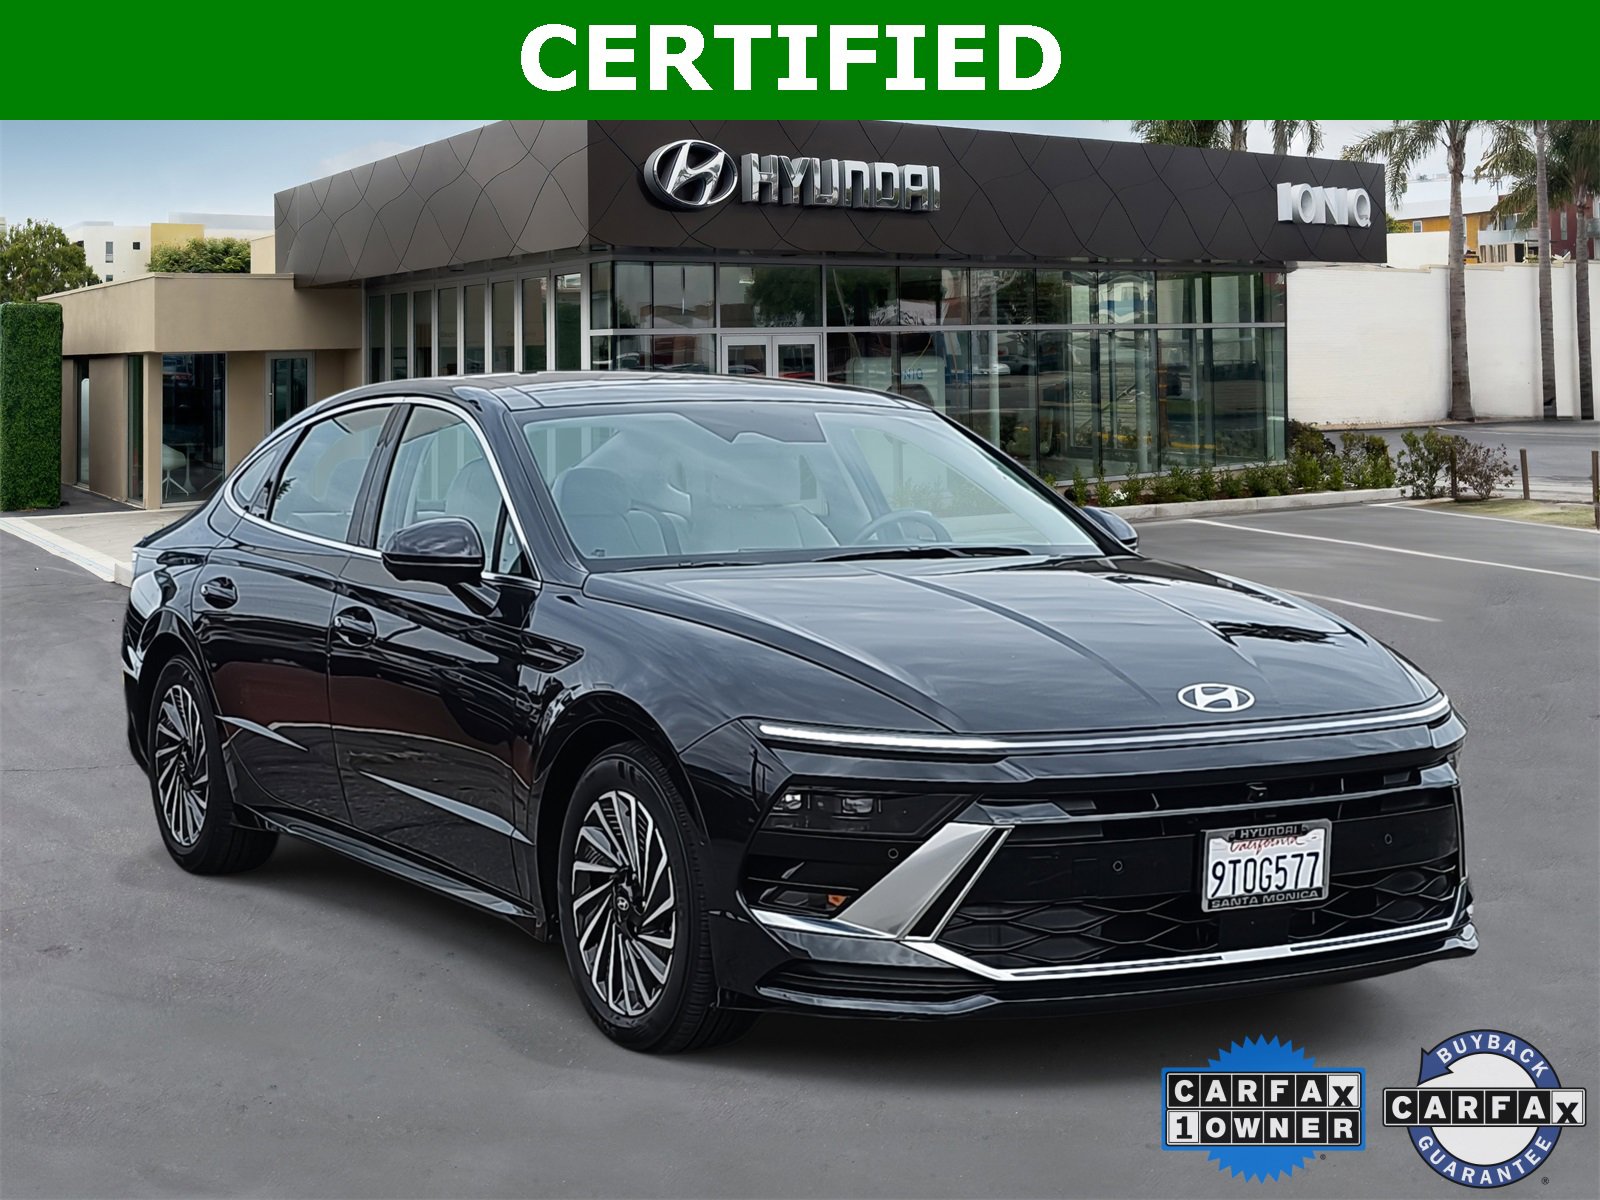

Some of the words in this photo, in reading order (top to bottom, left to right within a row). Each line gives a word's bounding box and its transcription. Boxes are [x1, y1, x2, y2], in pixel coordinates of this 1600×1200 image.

[741, 152, 941, 211] HYUNDAI
[1277, 182, 1371, 228] IONIQ
[1230, 836, 1305, 855] California
[1240, 825, 1298, 839] HYUNDAI
[1211, 851, 1320, 898] 9TOG577
[1211, 896, 1259, 909] SANTA
[1262, 890, 1319, 903] MONICA
